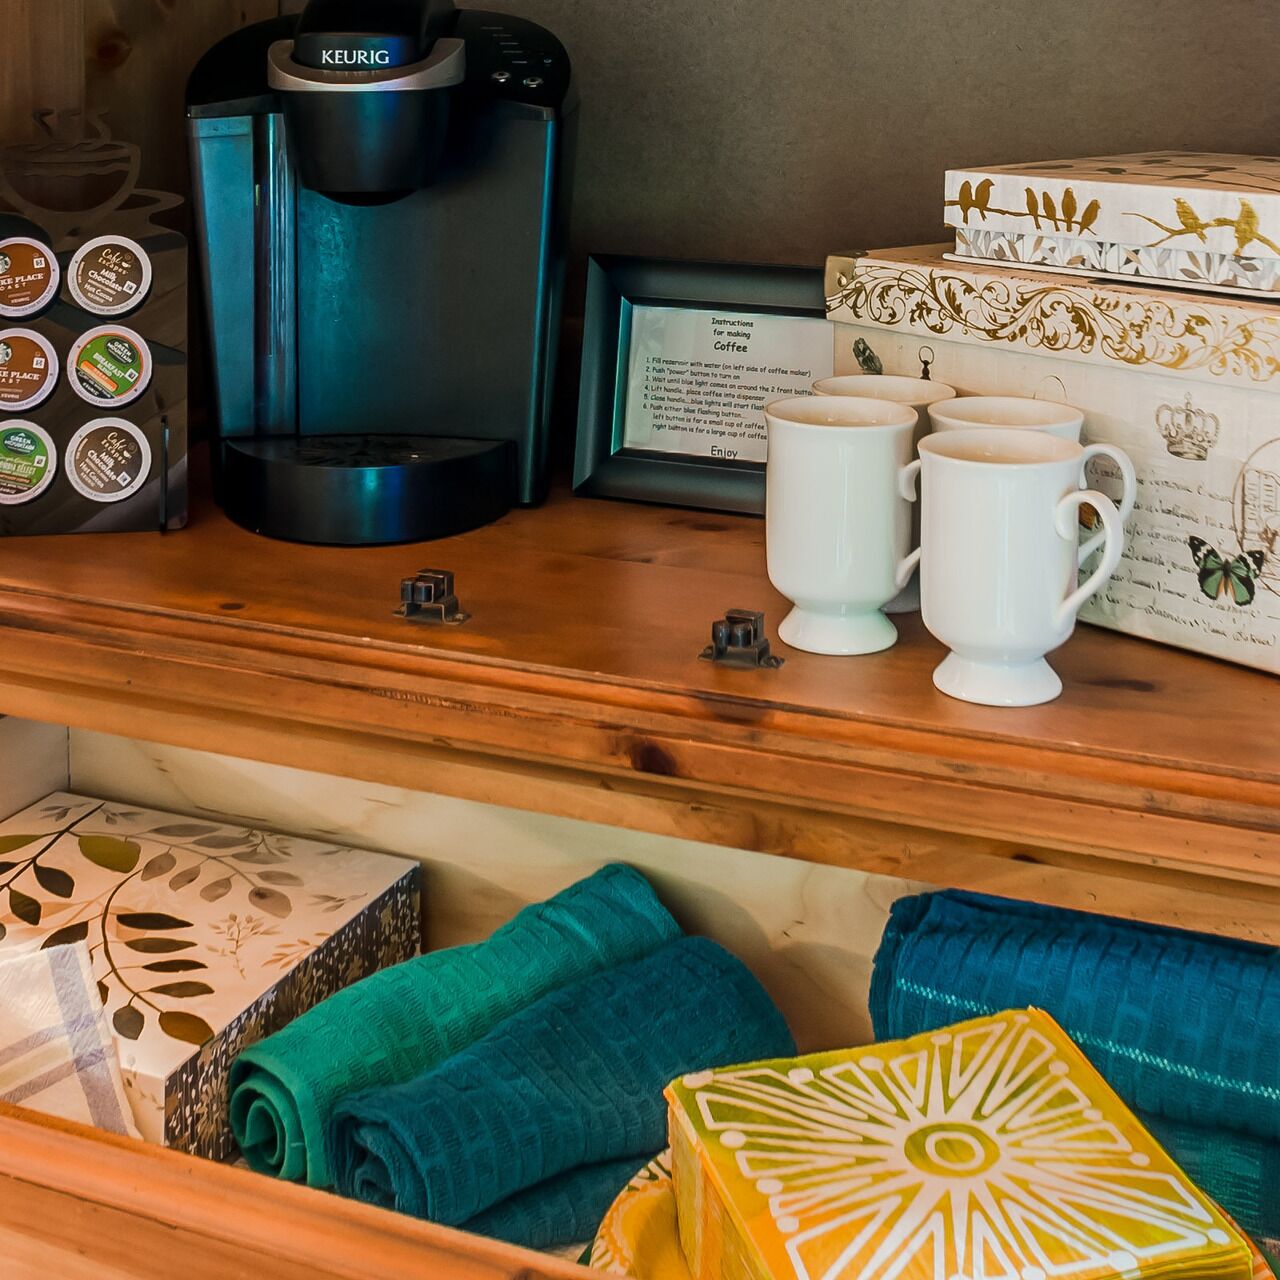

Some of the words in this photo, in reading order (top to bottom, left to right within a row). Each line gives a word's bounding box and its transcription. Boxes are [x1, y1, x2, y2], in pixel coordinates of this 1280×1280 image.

[321, 49, 389, 64] KEURIG
[15, 273, 44, 283] PLACE
[88, 270, 123, 292] Chocolate
[100, 269, 116, 281] Milk
[711, 317, 754, 327] Instructions
[713, 328, 724, 336] for
[727, 330, 751, 340] making
[713, 341, 748, 352] Coffee
[92, 352, 125, 378] BREAKFAST
[733, 363, 744, 371] left
[768, 367, 788, 375] coffee
[789, 369, 811, 378] maker)
[10, 371, 40, 381] PLACE
[652, 366, 666, 374] Push
[690, 370, 710, 378] button
[652, 375, 666, 383] Wait
[695, 379, 709, 387] light
[759, 385, 769, 393] the
[777, 386, 793, 394] front
[704, 399, 721, 407] lights
[650, 403, 663, 411] Push
[697, 407, 720, 418] flashing
[653, 412, 664, 420] left
[744, 422, 765, 430] coffee
[652, 423, 667, 431] right
[668, 424, 688, 432] button
[695, 426, 705, 434] for
[711, 428, 726, 437] large
[747, 432, 767, 440] coffee
[4, 439, 35, 450] MOUNTAIN
[10, 435, 31, 444] GREEN
[710, 445, 738, 458] Enjoy
[87, 449, 117, 481] Chocolate
[100, 451, 115, 467] Milk
